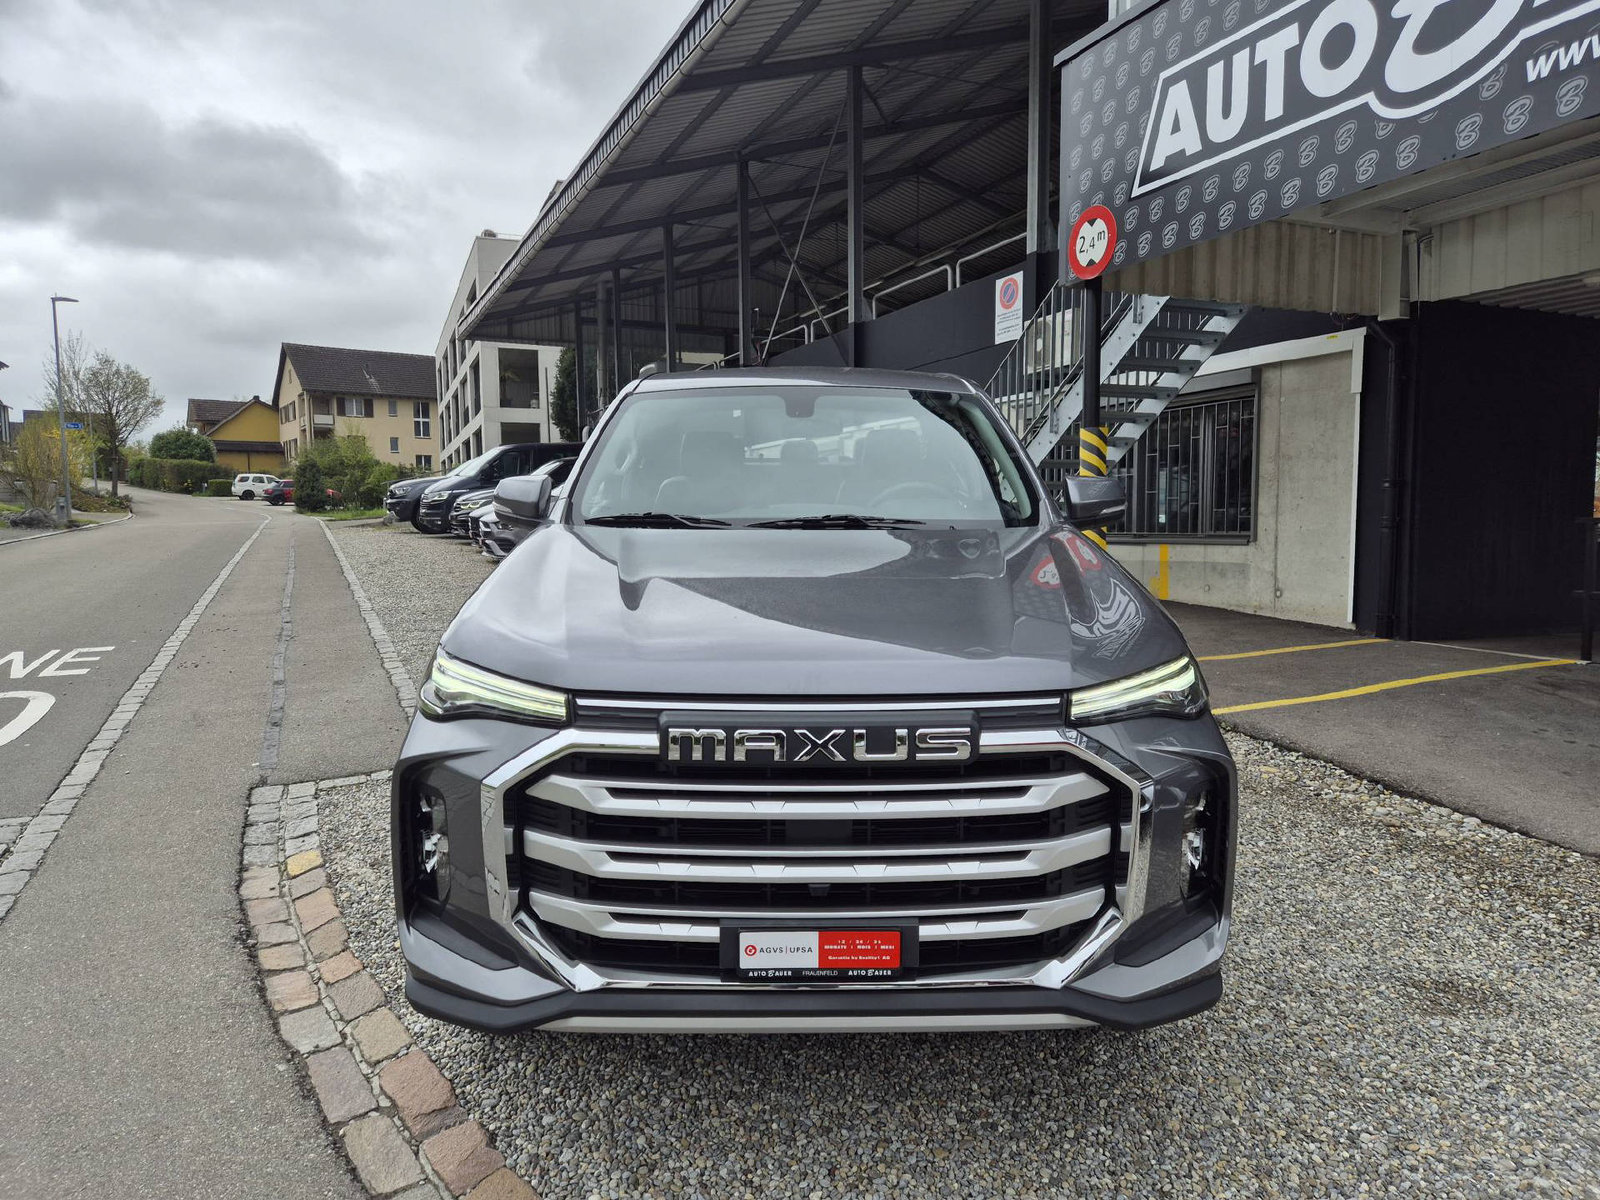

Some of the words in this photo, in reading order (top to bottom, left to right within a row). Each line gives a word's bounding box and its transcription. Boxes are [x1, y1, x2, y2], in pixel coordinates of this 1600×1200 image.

[1149, 0, 1378, 172] AUTO
[667, 727, 971, 762] MAXUS
[759, 946, 784, 954] AGVS
[789, 945, 813, 954] UPSA
